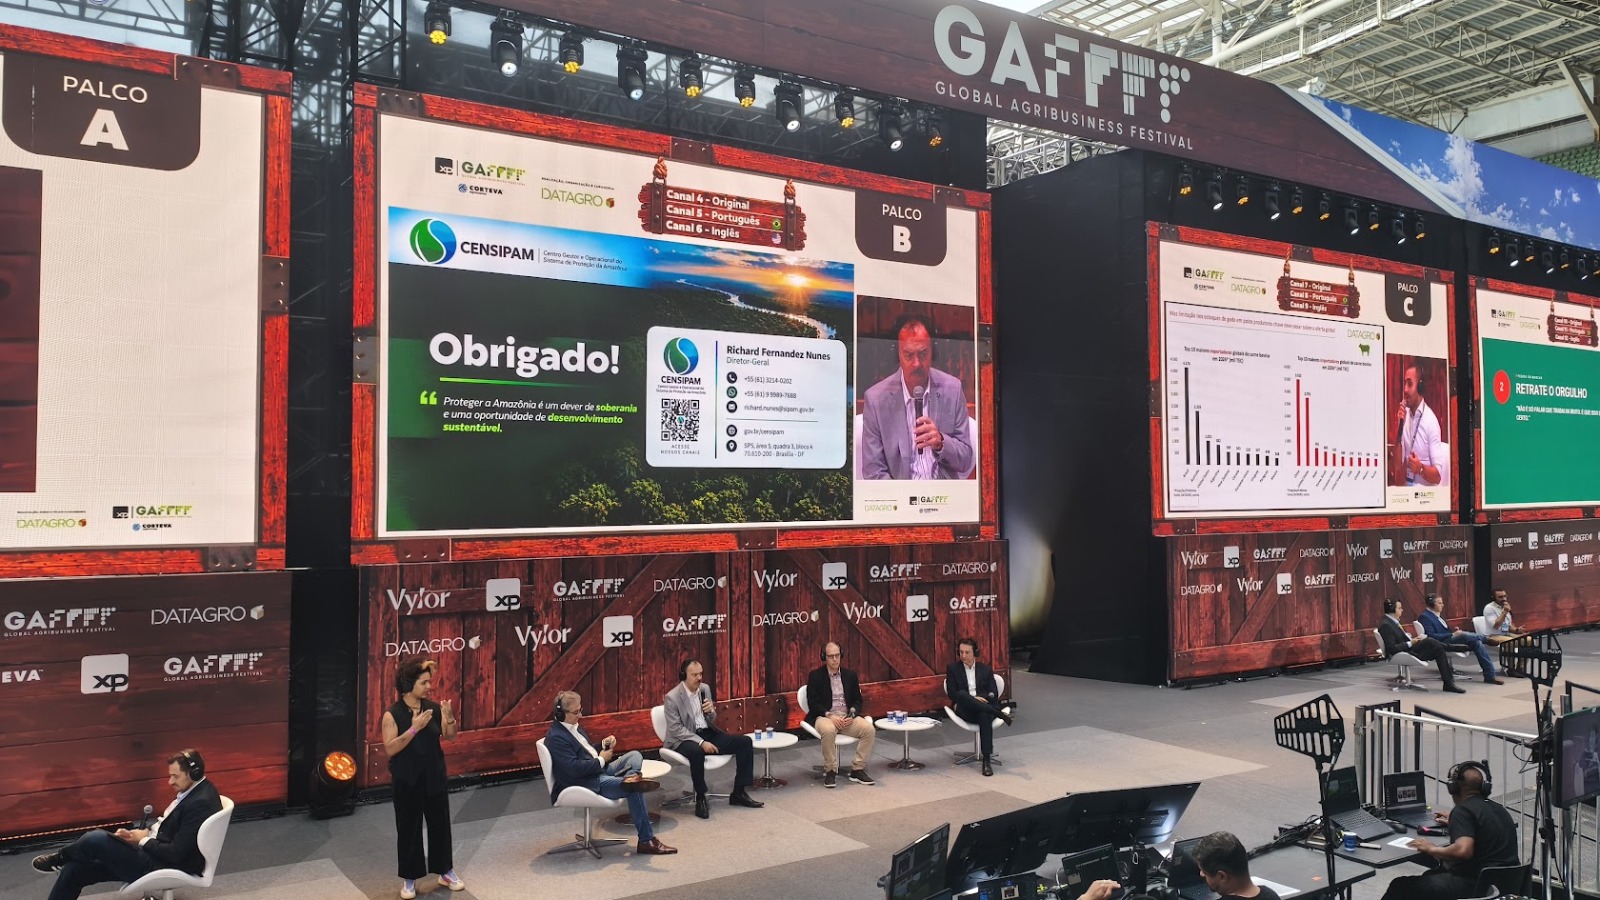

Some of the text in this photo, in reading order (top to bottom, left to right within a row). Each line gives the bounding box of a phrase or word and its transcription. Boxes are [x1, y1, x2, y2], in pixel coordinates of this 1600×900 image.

[63, 76, 148, 103] PALCO
[935, 81, 1193, 150] GLOBAL AGRIBUSINESS FESTIVAL
[80, 108, 129, 151] A
[469, 185, 503, 195] CORTEVA
[541, 187, 603, 207] DATAGRO
[666, 190, 749, 210] Canal 4 Original
[666, 205, 760, 225] Canal 5 Português
[882, 203, 922, 221] PALCO
[666, 221, 740, 238] Canal 6 Inglês
[893, 225, 912, 253] B
[460, 241, 534, 261] CENSIPAM
[543, 250, 561, 258] Centro
[585, 255, 614, 263] Operacional
[543, 257, 564, 265] Sistema
[1290, 280, 1305, 288] Canal
[1312, 283, 1331, 292] Original
[1290, 290, 1305, 298] Canal
[1397, 282, 1419, 294] PALCO
[1290, 301, 1305, 309] Canal
[1403, 297, 1414, 317] C
[1347, 329, 1375, 340] DATAGRO
[429, 332, 620, 378] Obrigado!
[726, 345, 831, 360] Richard Fernandez Nunes
[726, 357, 770, 366] Diretor-Geral
[661, 375, 701, 385] CENSIPAM
[754, 376, 765, 384] (61)
[765, 377, 793, 385] 3214-0202
[1499, 382, 1504, 392] 2
[1515, 383, 1588, 399] RETRATE O ORGULHO
[443, 397, 484, 409] Proteger
[492, 399, 536, 409] Amazônia
[538, 401, 544, 409] é
[545, 402, 559, 410] um
[560, 402, 583, 411] dever
[584, 402, 595, 411] de
[595, 403, 638, 413] soberania
[443, 411, 623, 424] e uma oportunidade de desenvolvimento
[443, 422, 503, 433] sustentável.
[17, 518, 76, 529] DATAGRO
[1300, 548, 1329, 558] DATAGRO
[1346, 543, 1369, 560] Vylor
[1440, 540, 1464, 550] DATAGRO
[1181, 551, 1209, 570] Vylor
[942, 562, 989, 576] DATAGRO
[1390, 566, 1412, 583] Vylor
[653, 576, 715, 592] DATAGRO
[753, 569, 798, 593] Vylor
[1237, 577, 1264, 596] Vylor
[1347, 573, 1375, 584] DATAGRO
[1181, 584, 1216, 596] DATAGRO
[386, 587, 451, 615] Vylor
[151, 605, 247, 625] DATAGRO
[752, 611, 809, 627] DATAGRO
[843, 601, 884, 624] Vylor
[34, 628, 84, 636] AGRIBUSINESS
[515, 624, 572, 651] Vylor
[385, 637, 465, 657] DATAGRO
[190, 673, 234, 681] AGRIBUSINESS
[236, 670, 263, 678] FESTIVAL
